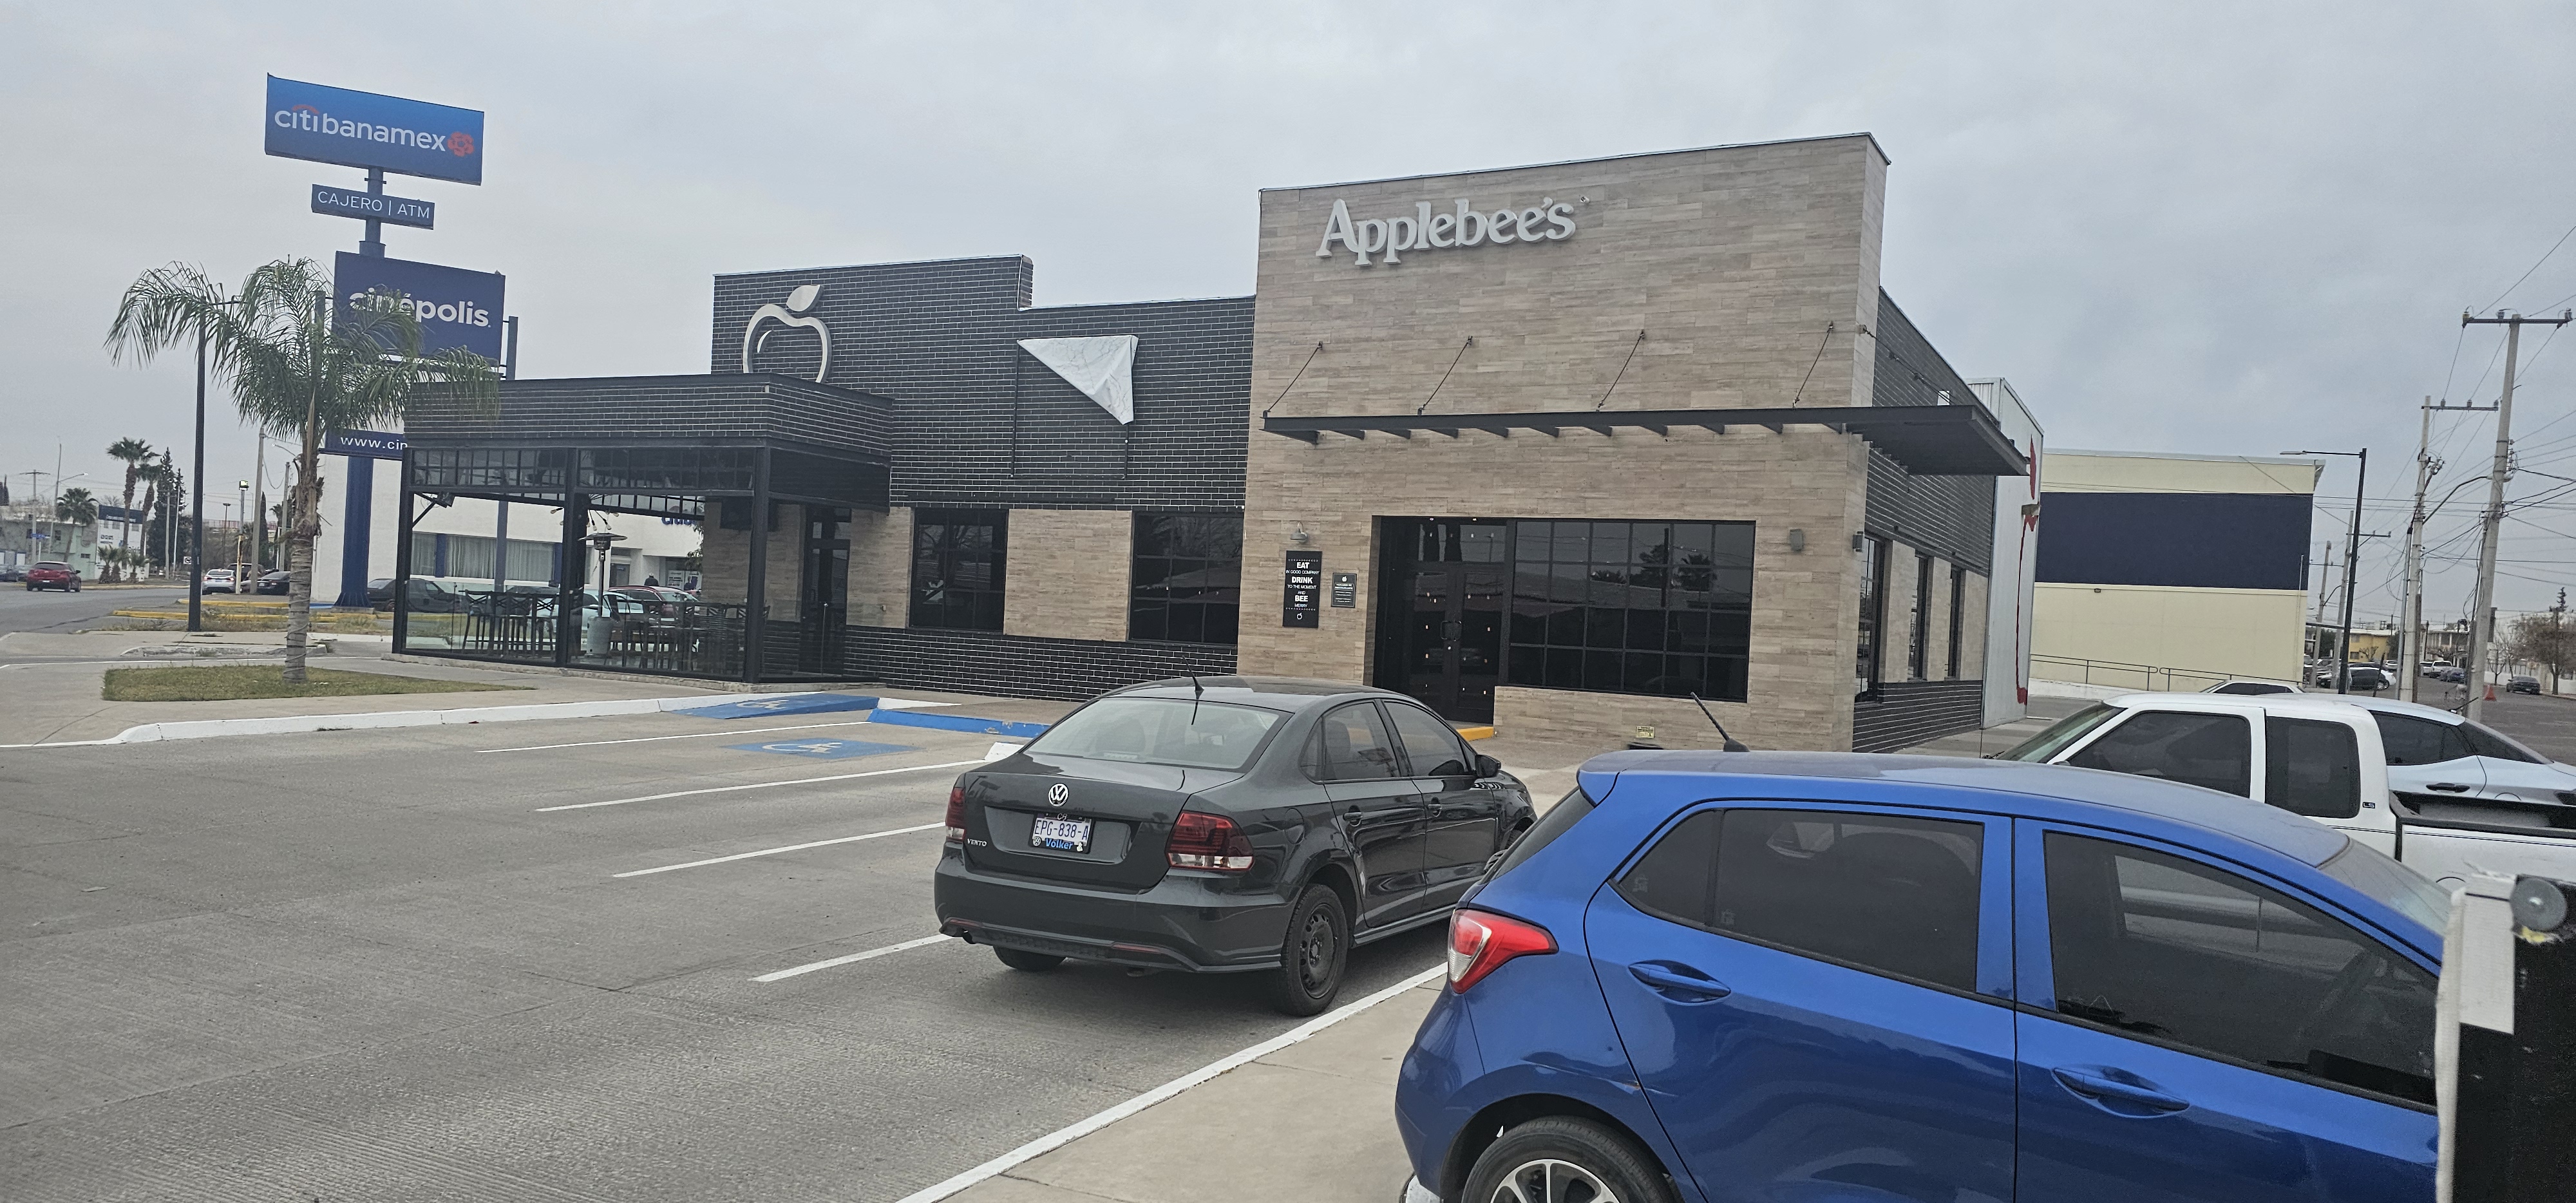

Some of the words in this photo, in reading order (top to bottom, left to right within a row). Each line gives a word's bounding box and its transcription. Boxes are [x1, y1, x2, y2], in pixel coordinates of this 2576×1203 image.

[274, 108, 446, 152] citibanamex
[317, 191, 383, 212] CAJERO
[397, 203, 430, 219] ATM
[1316, 196, 1576, 267] Applebee's
[1291, 576, 1313, 584] DRINK
[1034, 819, 1089, 840] EPG-838-A
[967, 838, 987, 847] VENTO
[1045, 837, 1074, 850] Volker
